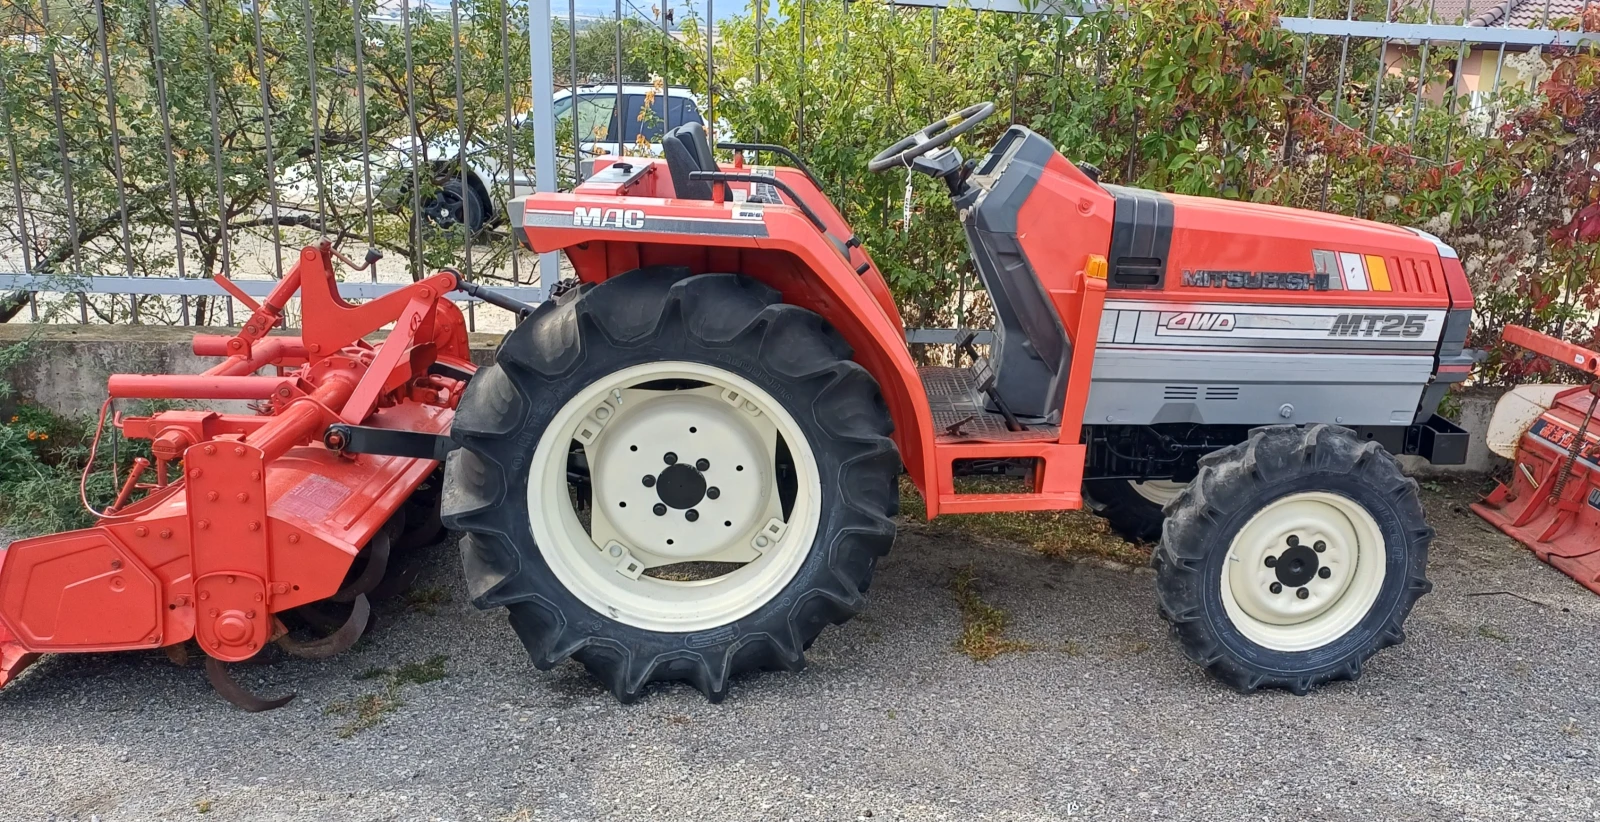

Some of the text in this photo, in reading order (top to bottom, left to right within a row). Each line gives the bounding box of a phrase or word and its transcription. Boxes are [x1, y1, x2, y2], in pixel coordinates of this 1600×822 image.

[573, 207, 645, 229] MAC
[1180, 269, 1330, 291] MITSUBISHI
[1328, 313, 1429, 338] MT25
